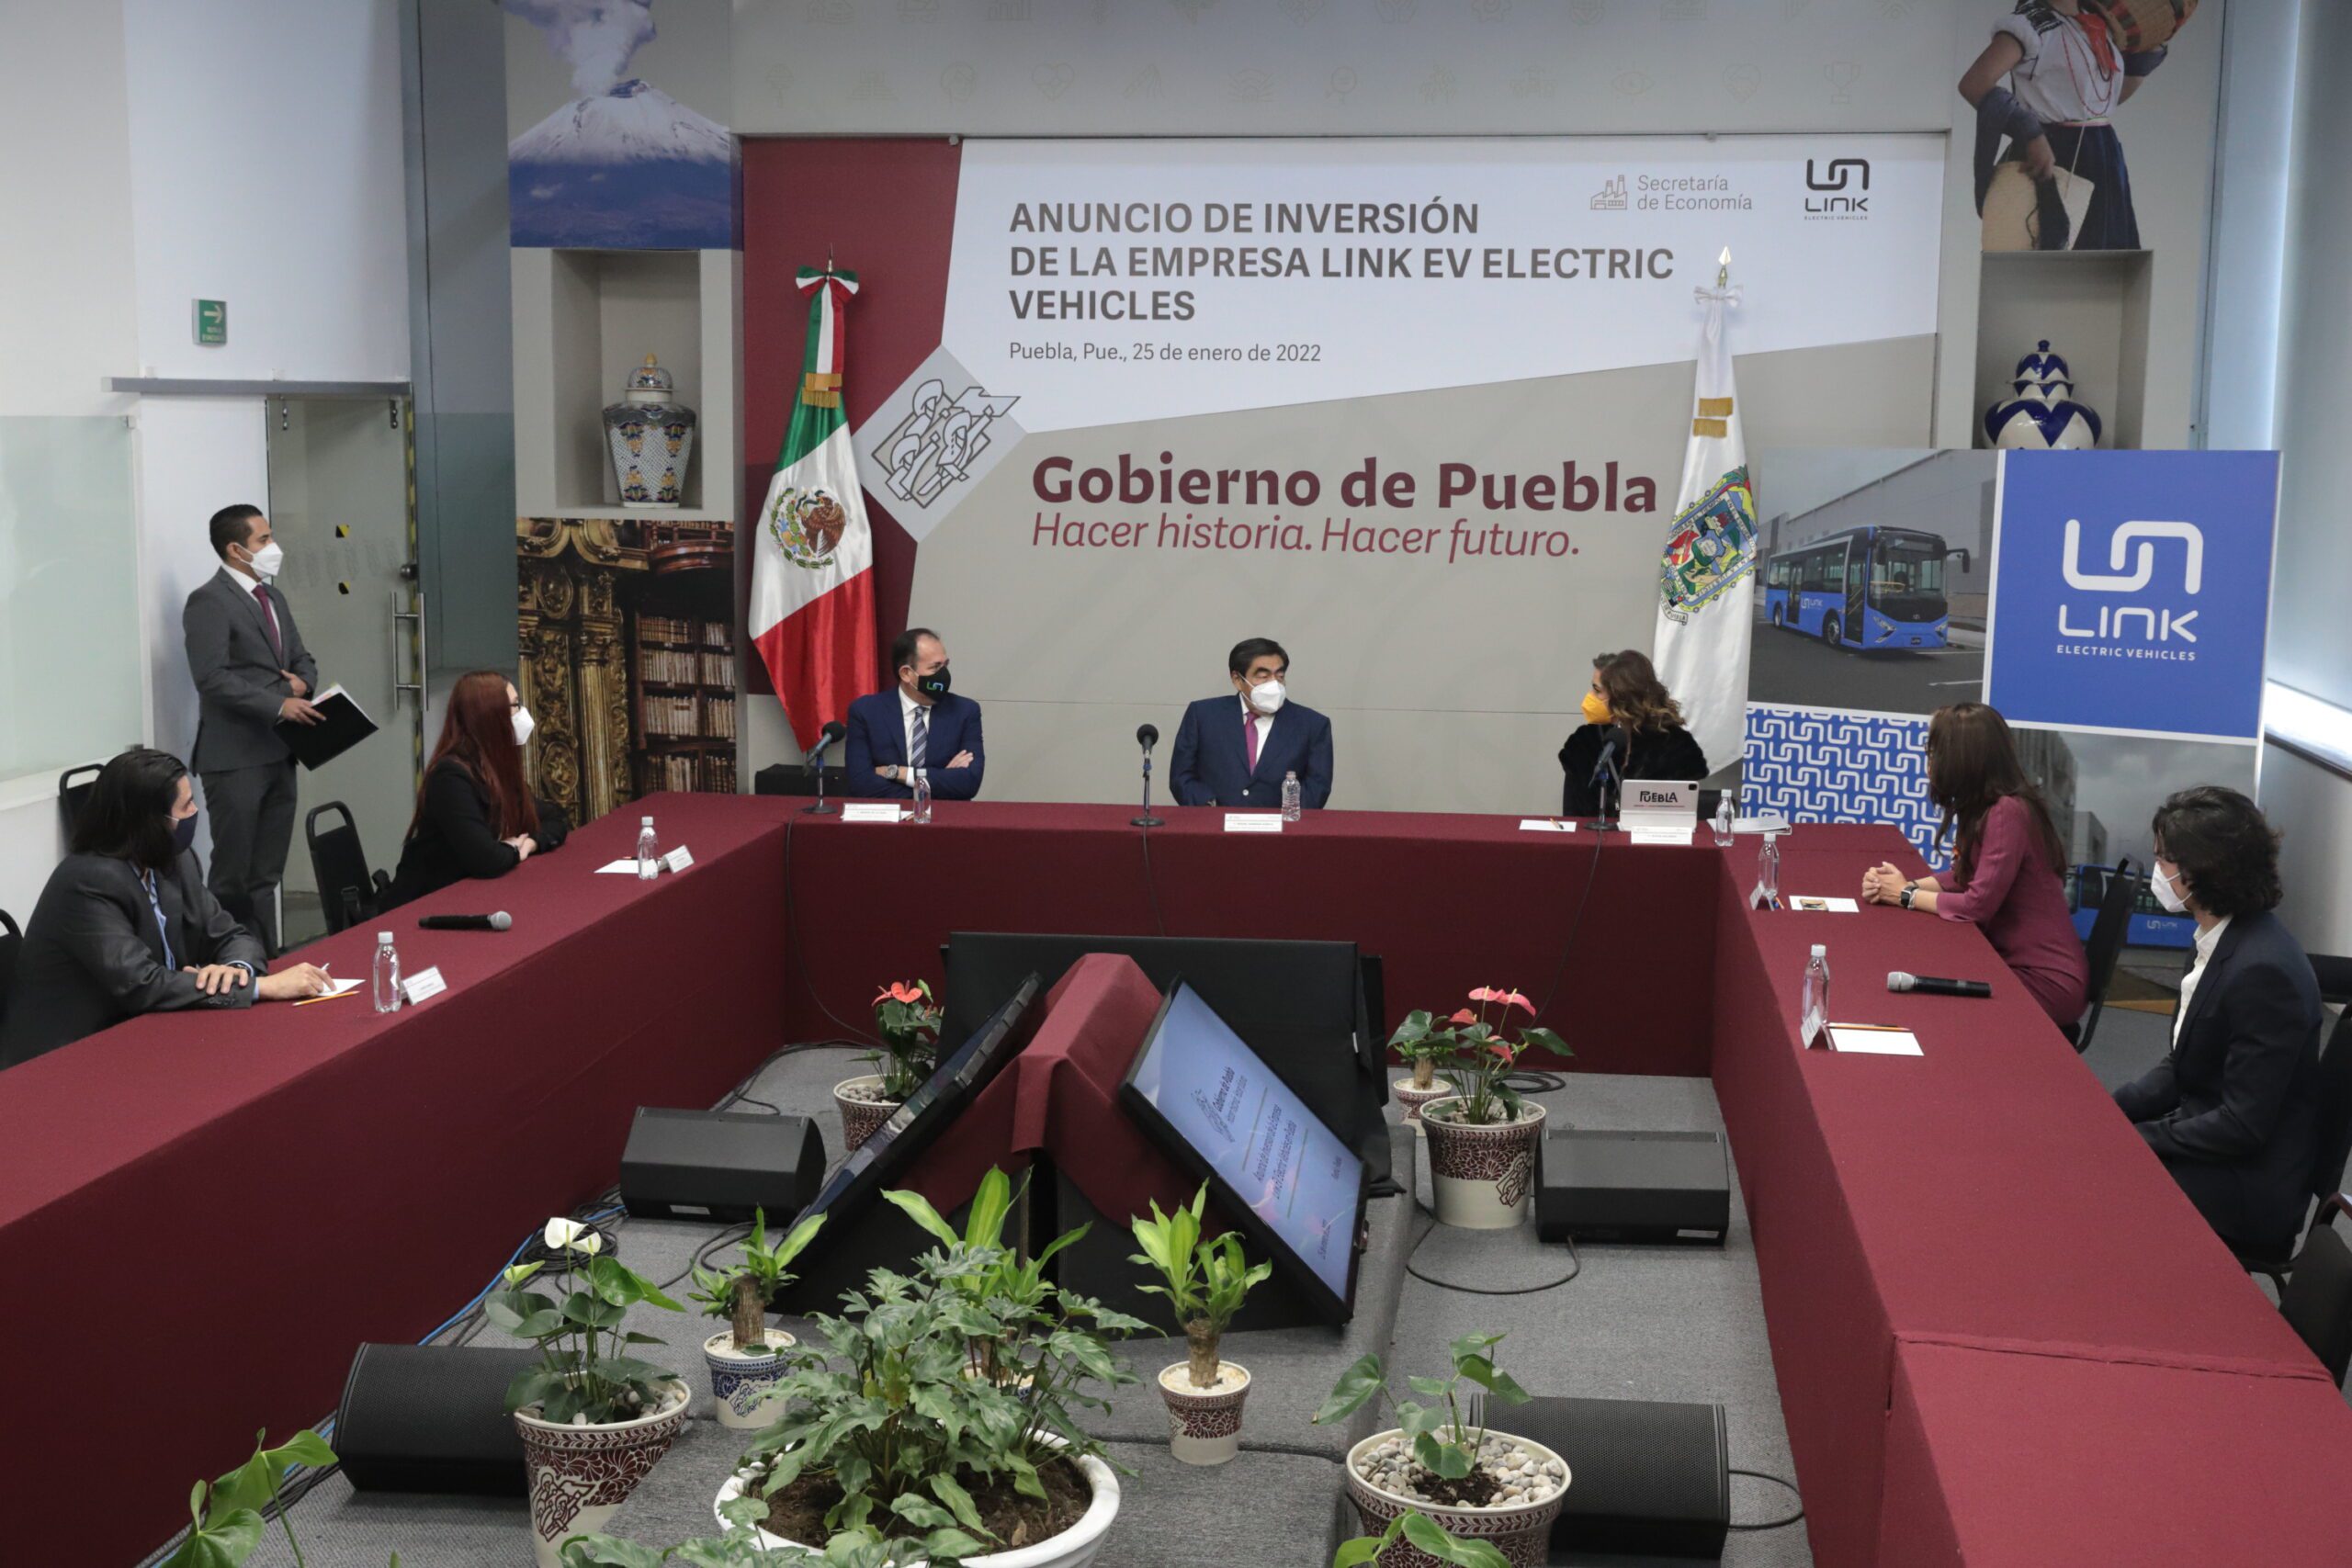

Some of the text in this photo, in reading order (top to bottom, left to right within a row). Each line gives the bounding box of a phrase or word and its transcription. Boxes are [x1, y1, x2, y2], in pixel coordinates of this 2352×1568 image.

[1638, 175, 1728, 191] Secretaría
[1637, 194, 1752, 209] de Economía
[1010, 196, 1477, 233] ANUNCIO DE INVERSIÓN
[1012, 247, 1673, 279] DE LA EMPRESA LINK EV ELECTRIC
[1009, 290, 1194, 321] VEHICLES
[1011, 342, 1320, 362] Puebla, Pue., 25 de enero de 2022
[1033, 451, 1656, 513] Gobierno de Puebla
[1033, 513, 1578, 563] Hacer historia. Hacer futuro.
[2057, 645, 2195, 660] ELECTRIC VEHICLES
[1640, 791, 1678, 803] PUEBLA
